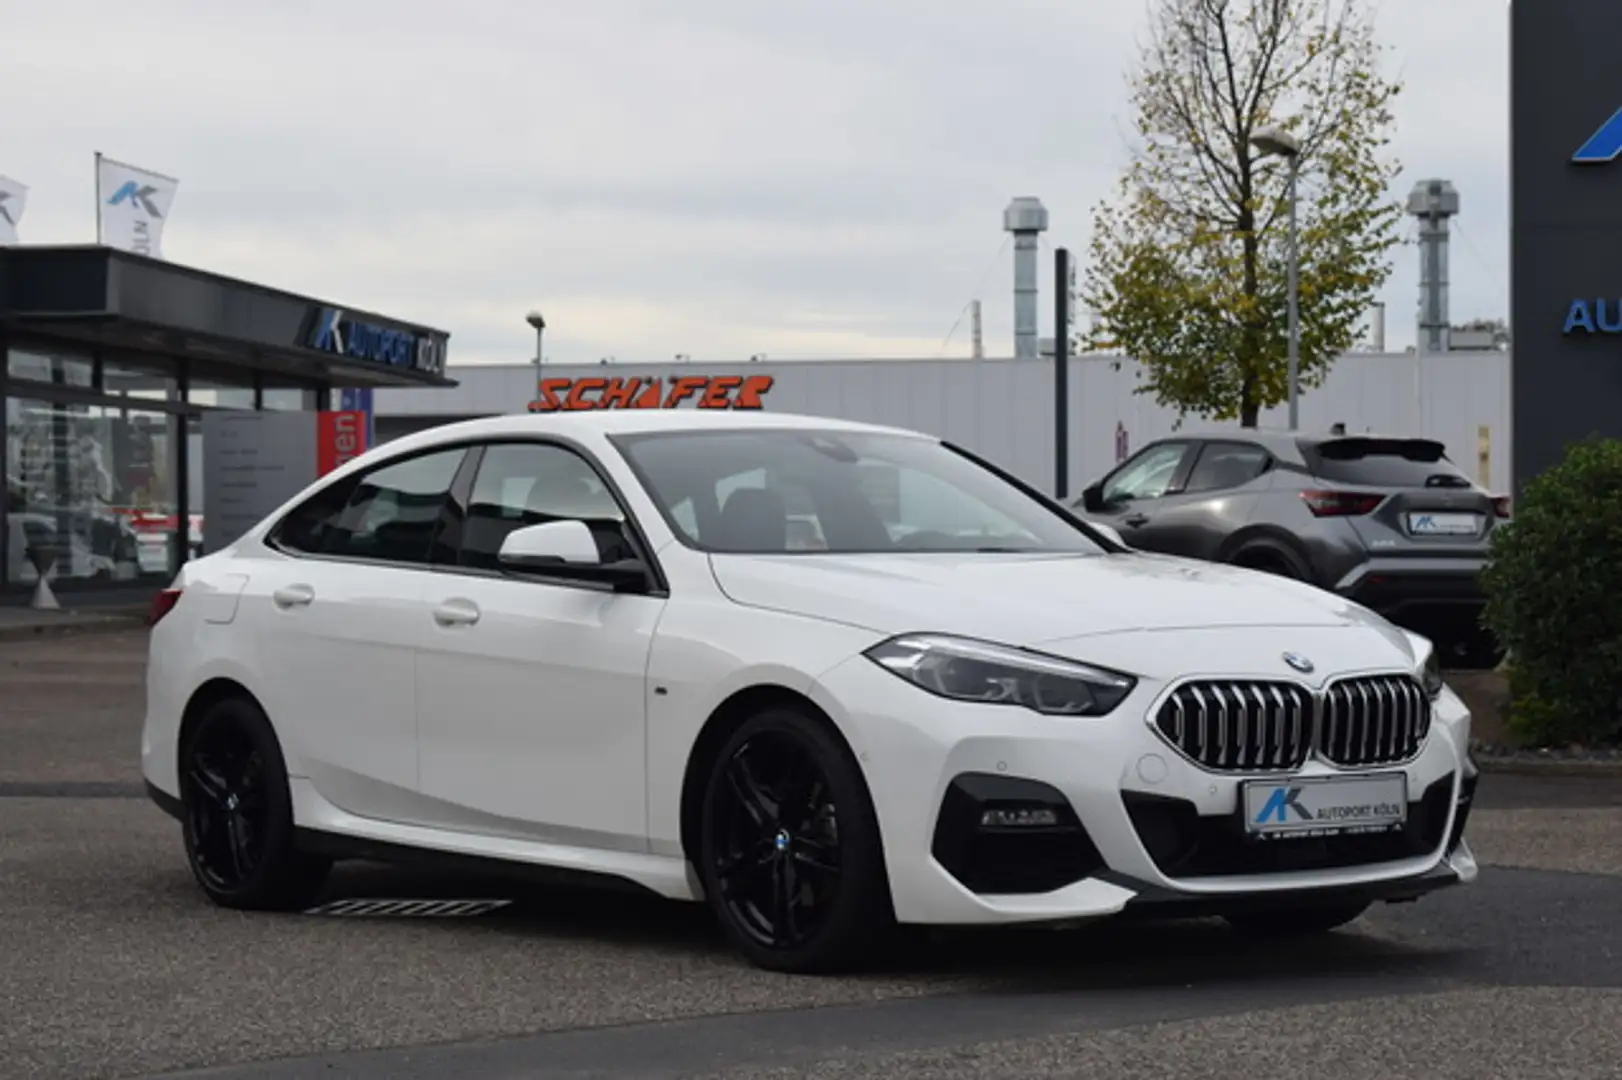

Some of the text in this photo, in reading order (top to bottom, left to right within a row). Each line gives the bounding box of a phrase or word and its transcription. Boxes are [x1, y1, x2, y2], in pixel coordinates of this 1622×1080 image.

[527, 375, 774, 412] SCHÄFER
[1256, 786, 1400, 823] AK AUTOPORT KÖLN
